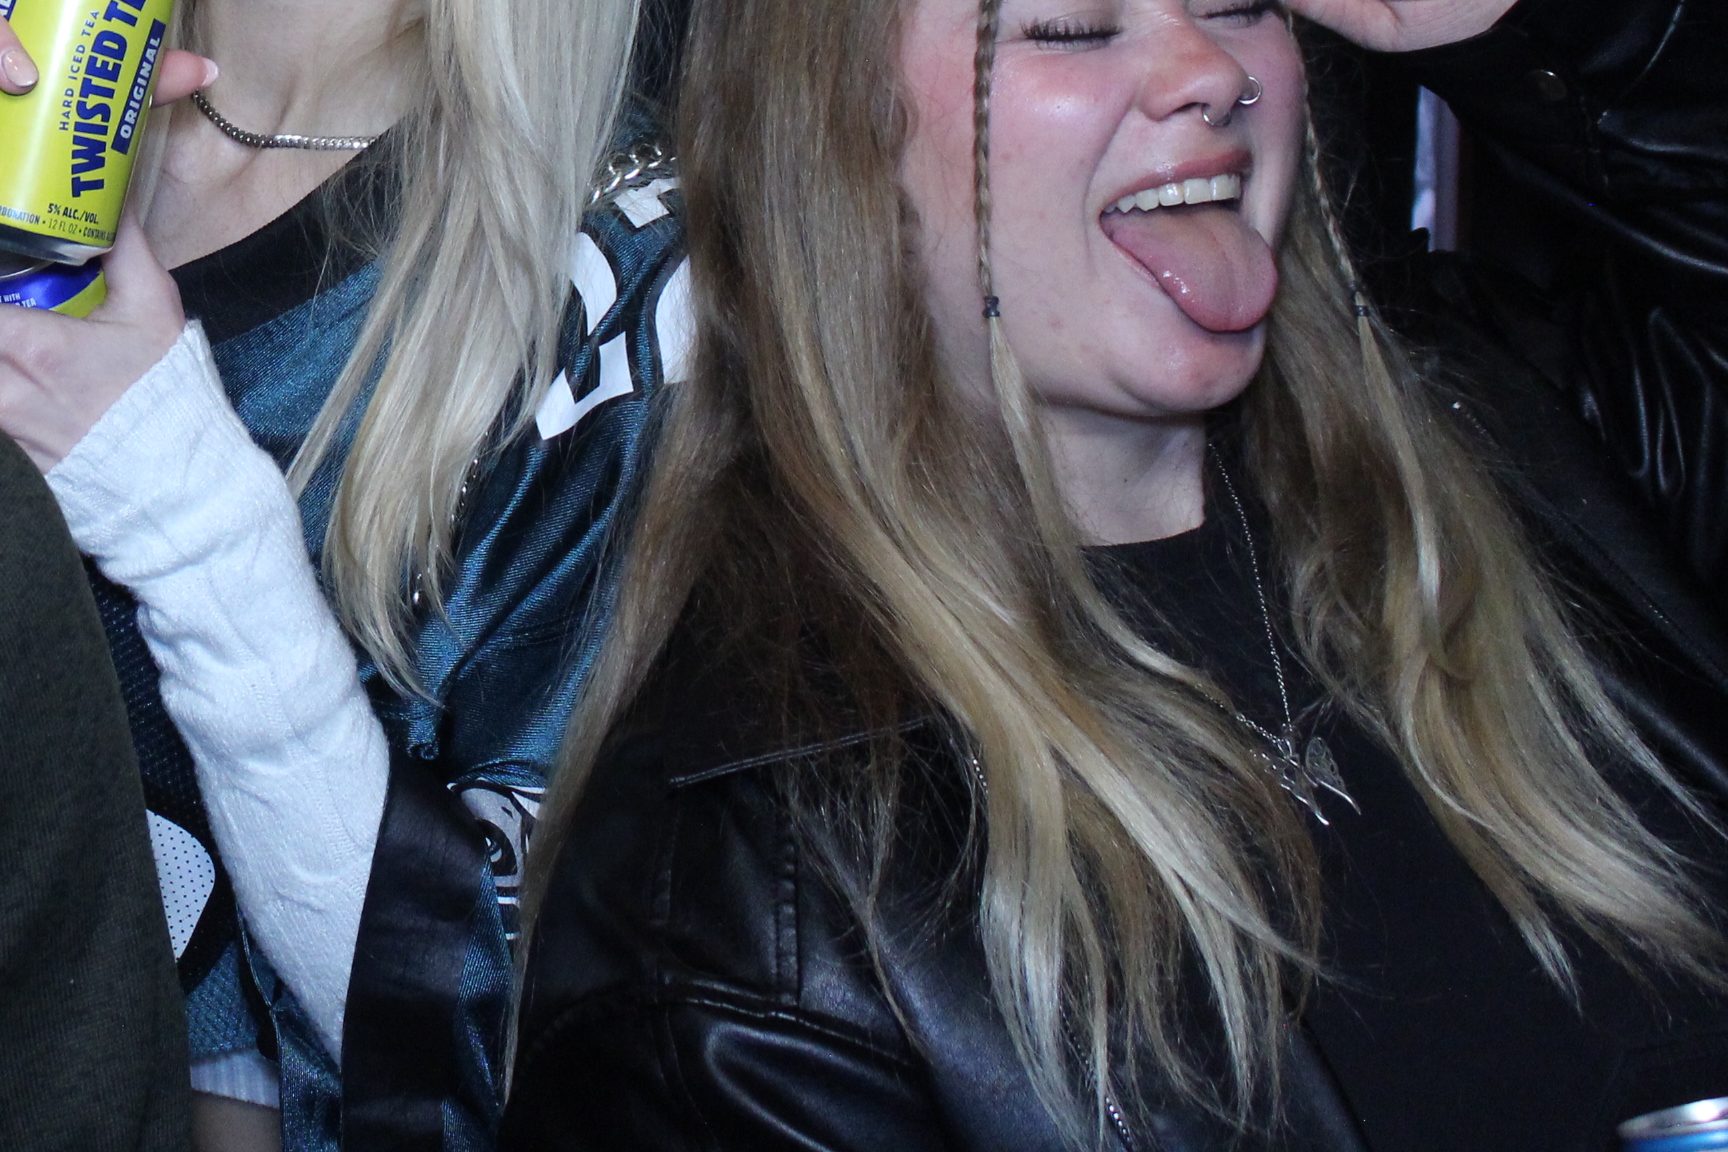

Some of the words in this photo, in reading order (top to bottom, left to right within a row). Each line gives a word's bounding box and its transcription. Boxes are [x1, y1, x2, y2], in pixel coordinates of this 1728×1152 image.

[59, 87, 75, 131] HARD
[68, 44, 87, 80] ICED
[81, 10, 100, 37] TEA
[120, 36, 161, 139] ORIGINAL
[71, 30, 128, 198] TWISTED
[47, 203, 61, 216] 5%
[62, 207, 99, 225] ALC./VOL.
[48, 218, 58, 230] 12
[58, 221, 66, 232] FL
[68, 223, 78, 235] OZ
[83, 226, 107, 241] CONTAINS
[3, 292, 21, 303] WITH
[21, 297, 37, 308] TEA
